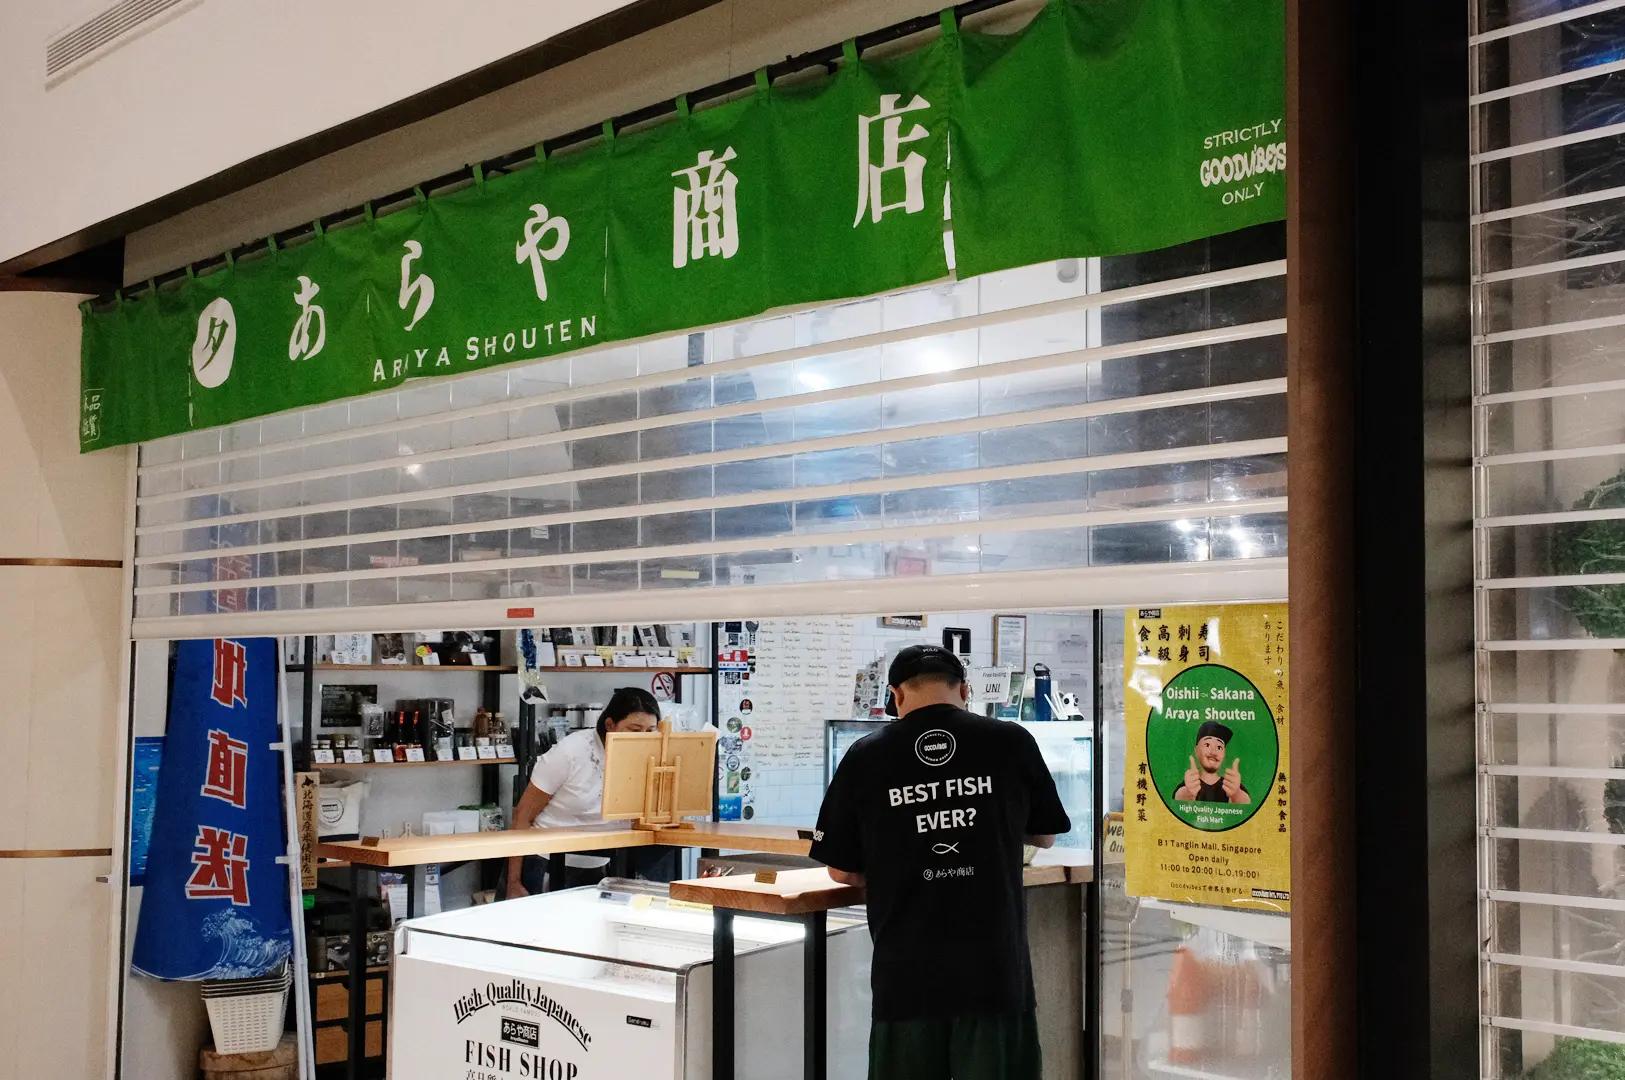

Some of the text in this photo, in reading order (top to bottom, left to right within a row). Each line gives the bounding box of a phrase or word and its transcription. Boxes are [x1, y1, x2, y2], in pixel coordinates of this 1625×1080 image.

[1204, 118, 1282, 149] STRICTLY
[1200, 142, 1286, 187] GOODVIBES
[1222, 181, 1264, 205] ONLY
[465, 315, 598, 361] SHOUTEN
[985, 683, 1001, 693] UNI
[1166, 687, 1254, 700] Oishii Sakana
[1165, 707, 1256, 722] Araya Shouten
[889, 775, 992, 807] BEST FISH
[1136, 761, 1148, 822] 有機野菜
[916, 808, 977, 833] EVER?
[1179, 804, 1243, 816] High Quality Japanese
[1197, 815, 1224, 824] Fish Mart
[1170, 839, 1199, 850] Tanglin
[1221, 843, 1262, 854] Singapore
[1160, 863, 1181, 872] 11:00
[1182, 865, 1190, 873] to
[1191, 865, 1214, 875] 20:00
[1188, 853, 1230, 866] Open daily
[532, 986, 593, 1048] Japanese
[503, 1021, 538, 1041] あらや商店
[465, 1039, 578, 1080] FISH SHOP
